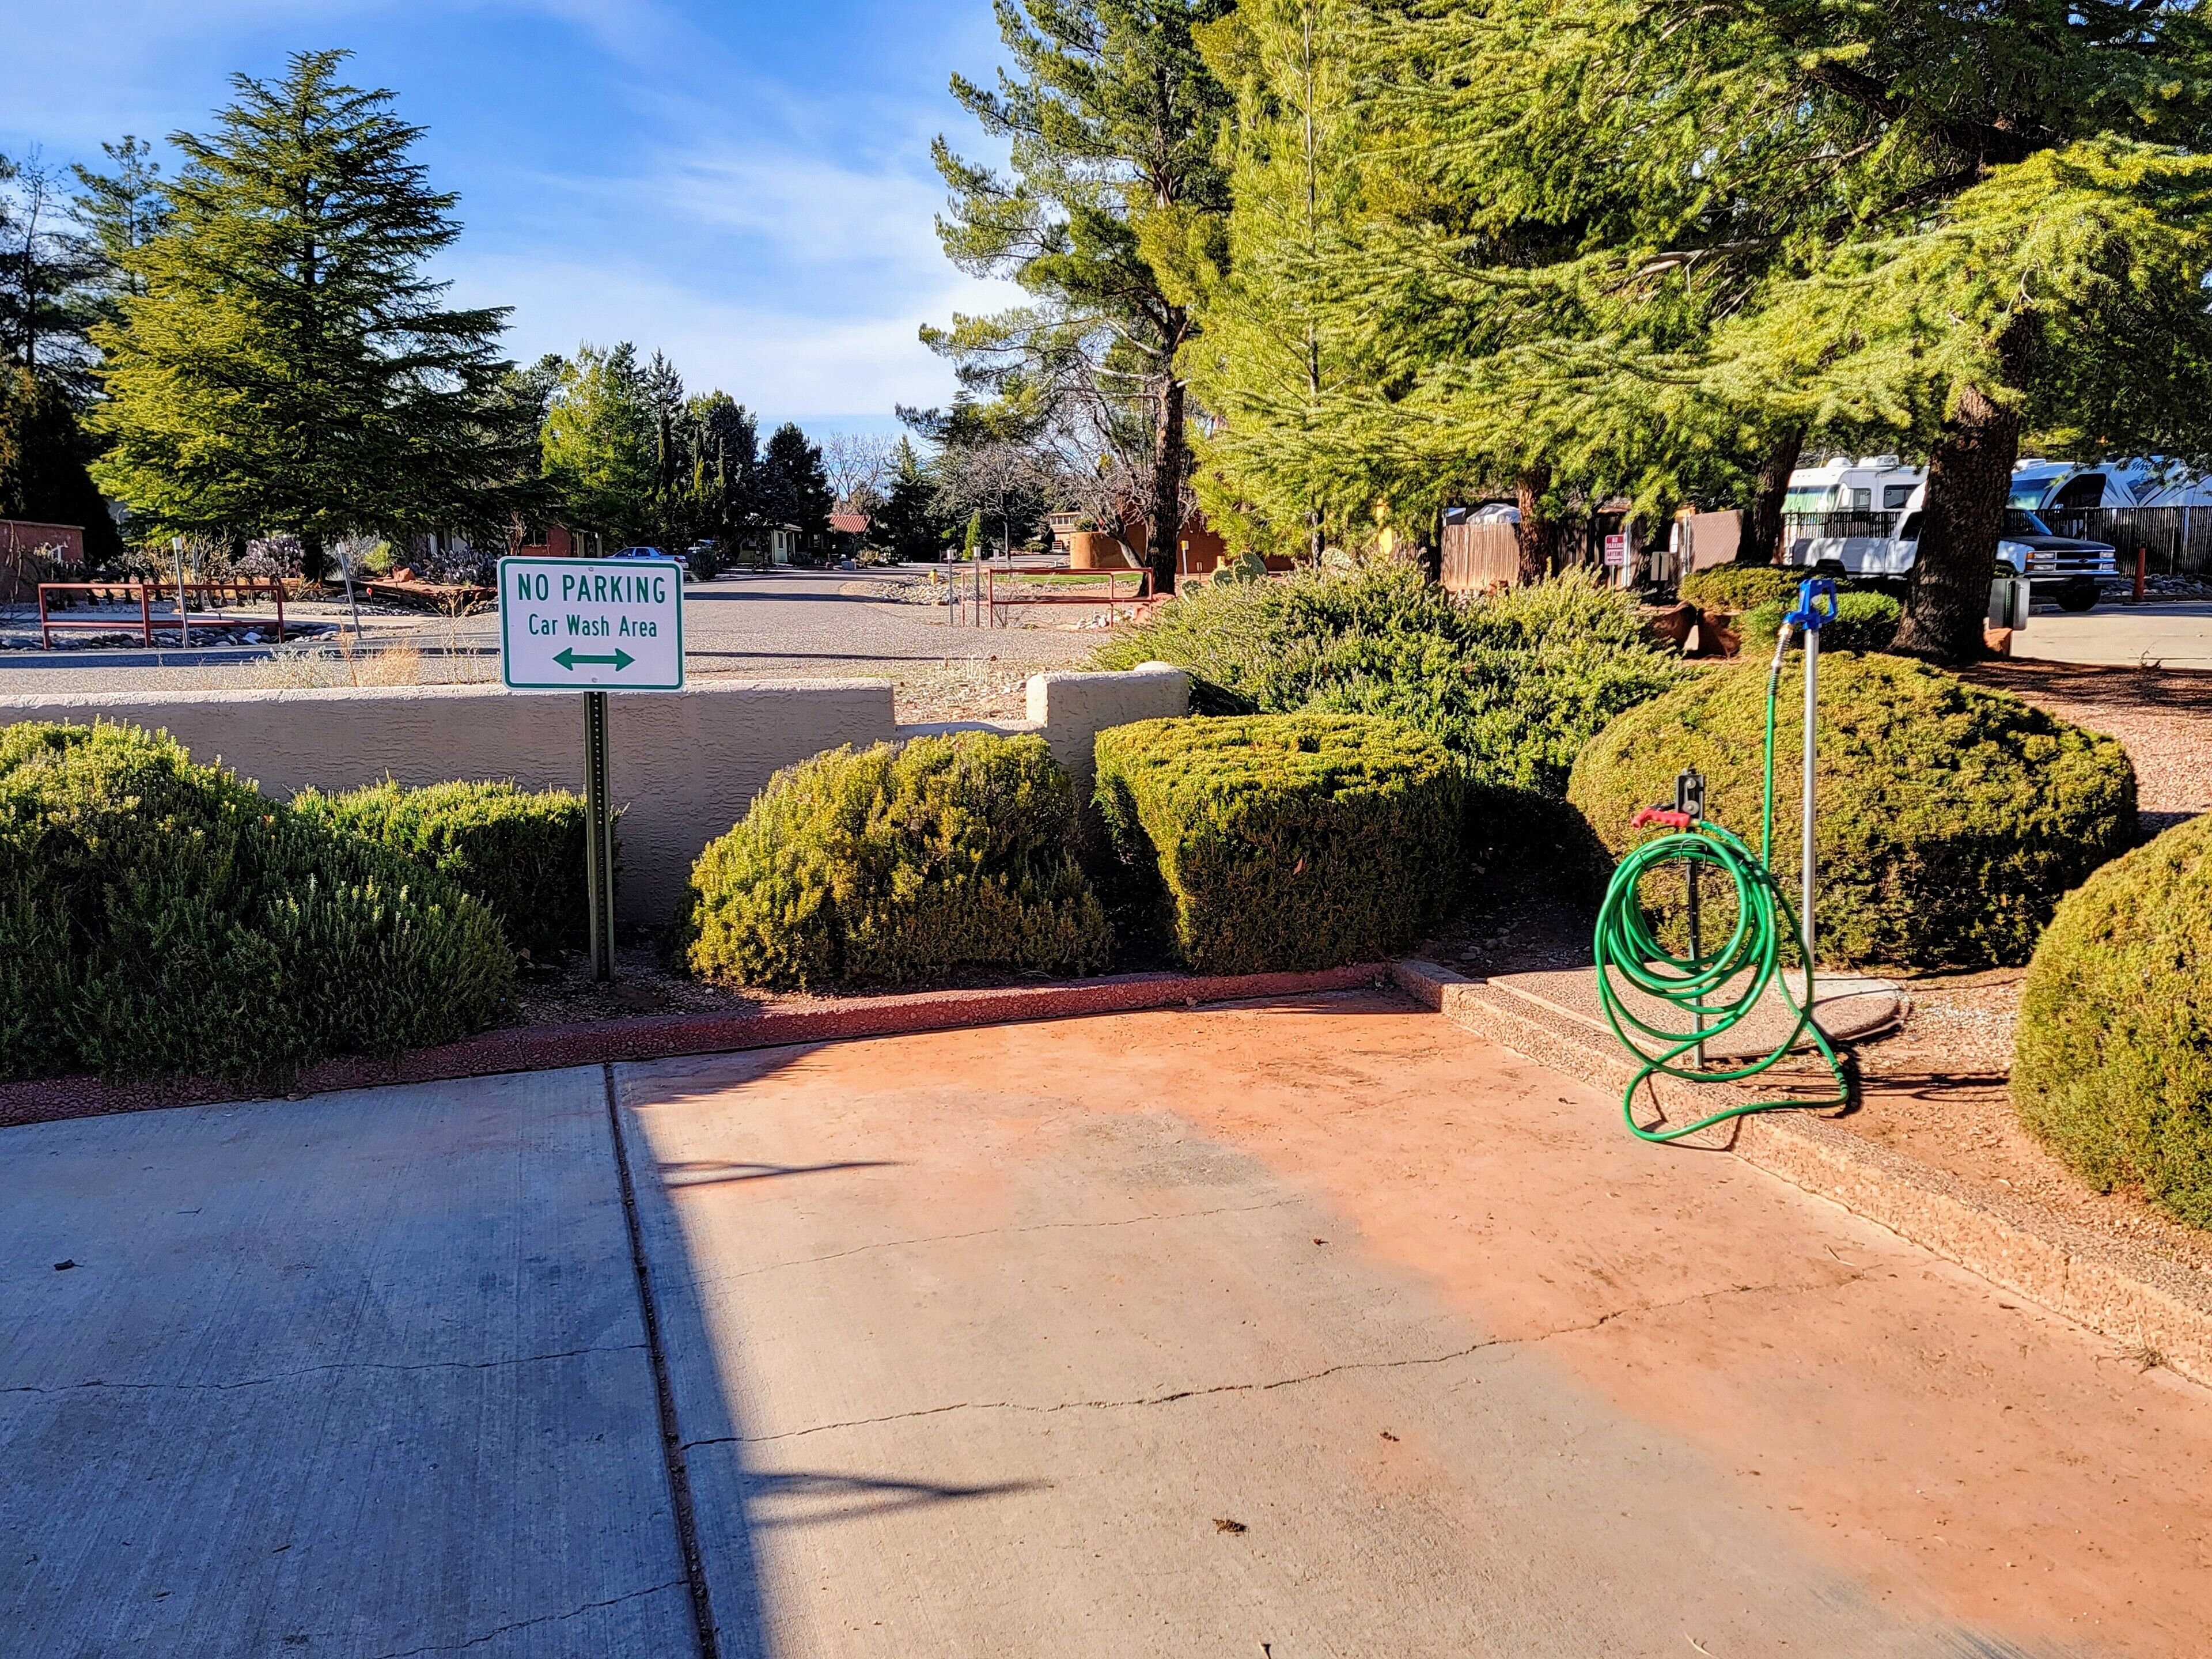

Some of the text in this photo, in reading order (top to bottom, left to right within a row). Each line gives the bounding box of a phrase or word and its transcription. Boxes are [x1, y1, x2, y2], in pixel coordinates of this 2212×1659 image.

[518, 573, 665, 603] NO PARKING
[529, 613, 657, 637] Car Wash Area
